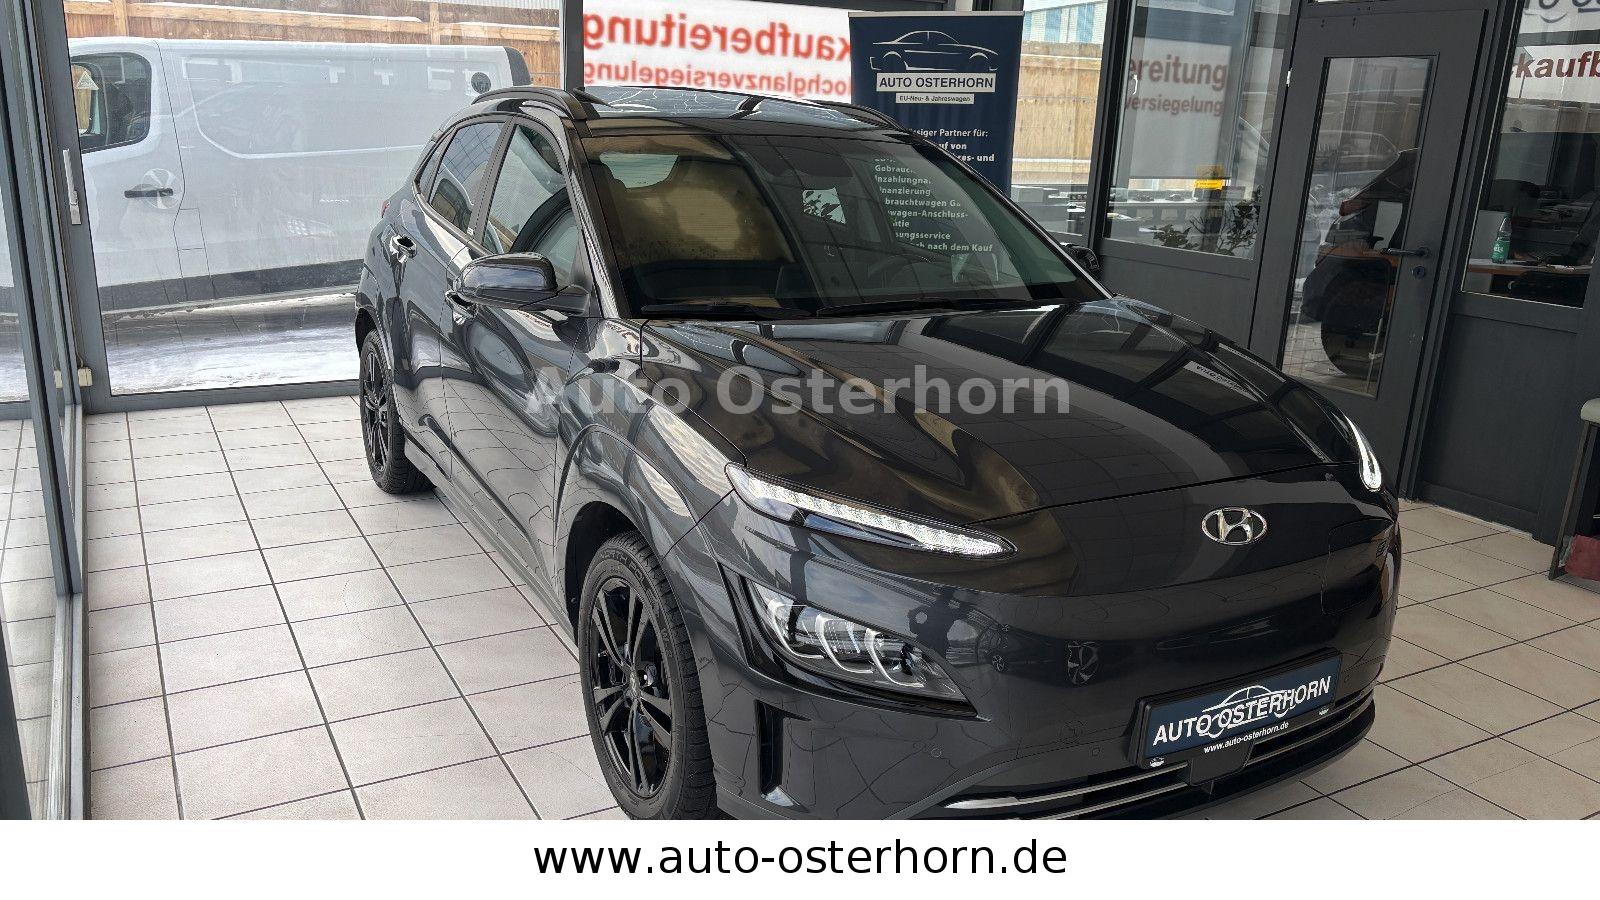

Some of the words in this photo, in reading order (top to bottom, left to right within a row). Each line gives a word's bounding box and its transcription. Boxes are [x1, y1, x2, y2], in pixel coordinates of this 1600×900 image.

[879, 77, 912, 88] AUTO
[915, 77, 993, 88] OSTERHORN
[939, 129, 972, 137] Partner
[973, 128, 989, 137] für:
[976, 153, 995, 162] und
[927, 243, 948, 251] nach
[950, 243, 970, 251] dem
[971, 244, 993, 252] Kauf
[1152, 714, 1212, 747] AUTO
[1217, 675, 1332, 727] OSTERHORN
[1203, 721, 1290, 755] www.auto-osterhorn.de
